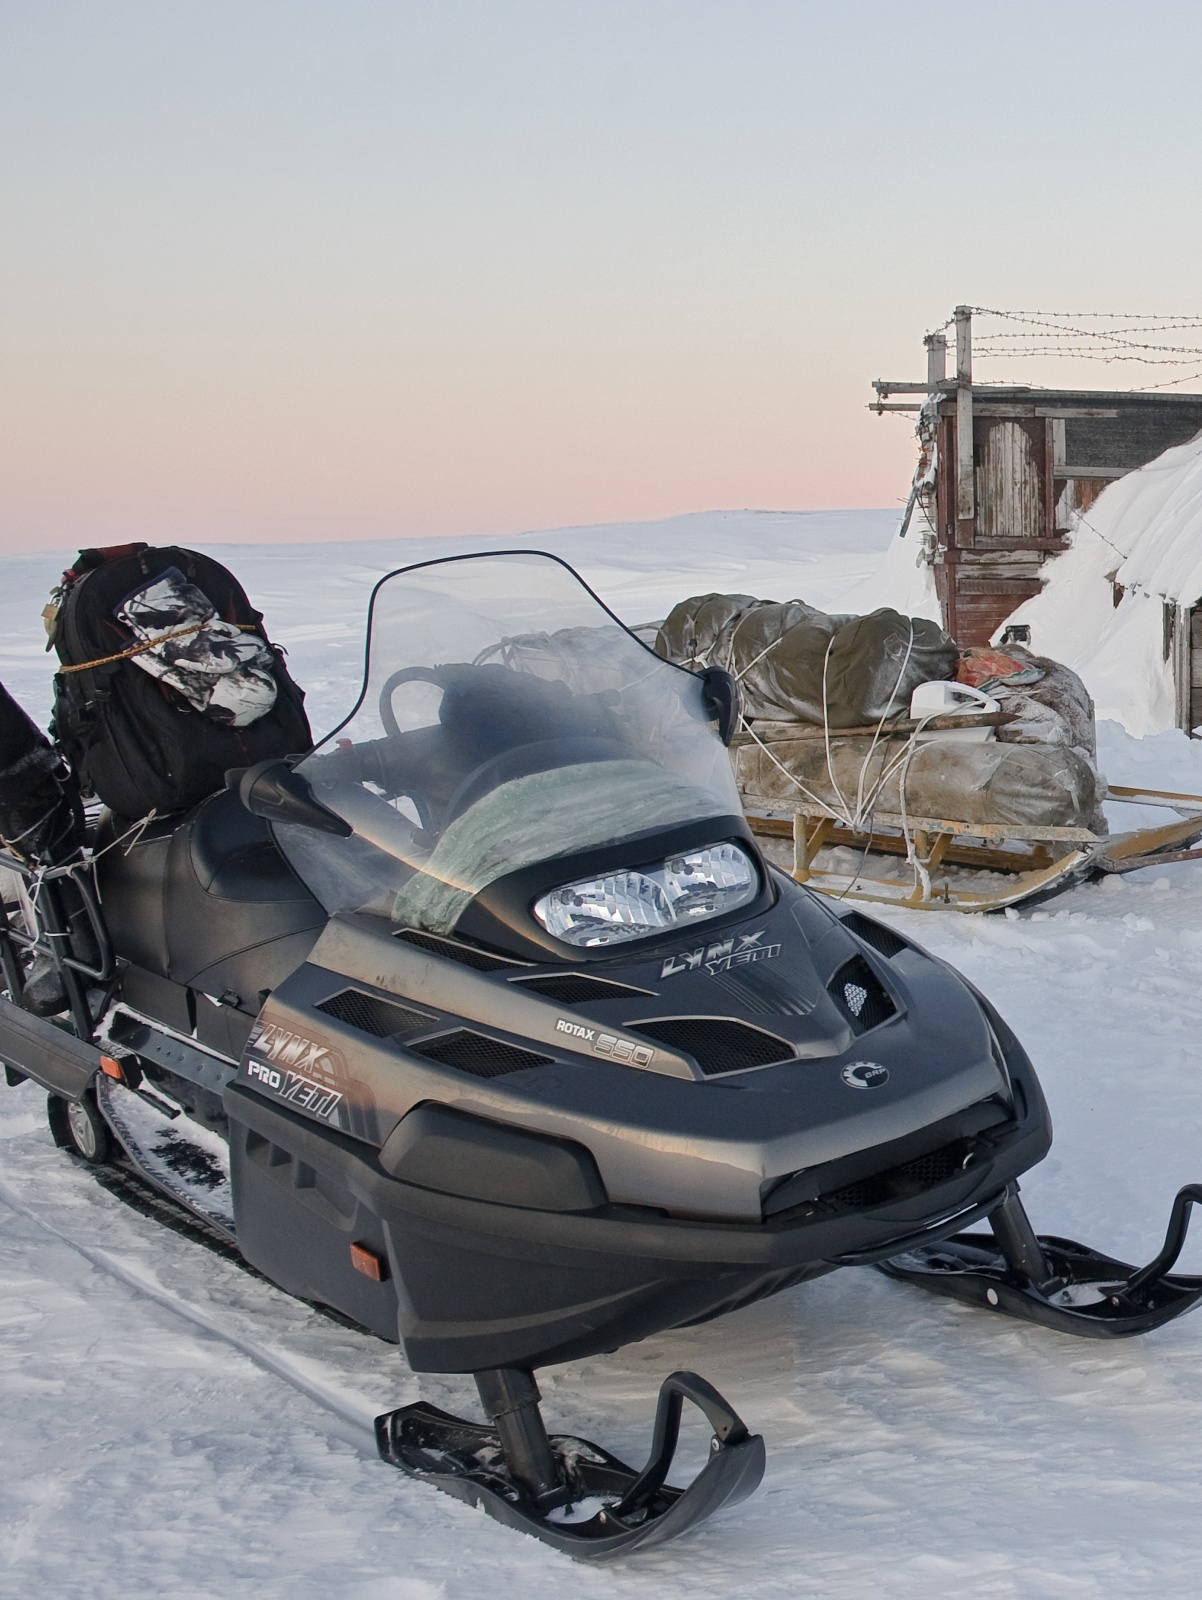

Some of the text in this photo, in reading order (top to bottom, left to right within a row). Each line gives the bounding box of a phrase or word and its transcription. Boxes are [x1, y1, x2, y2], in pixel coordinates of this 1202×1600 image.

[660, 930, 765, 979] LYNX
[704, 943, 781, 976] YETI
[253, 1023, 330, 1073] LYNX
[556, 1019, 595, 1041] ROTAX
[247, 1060, 343, 1117] PRO YETI
[864, 1068, 886, 1079] BRP
